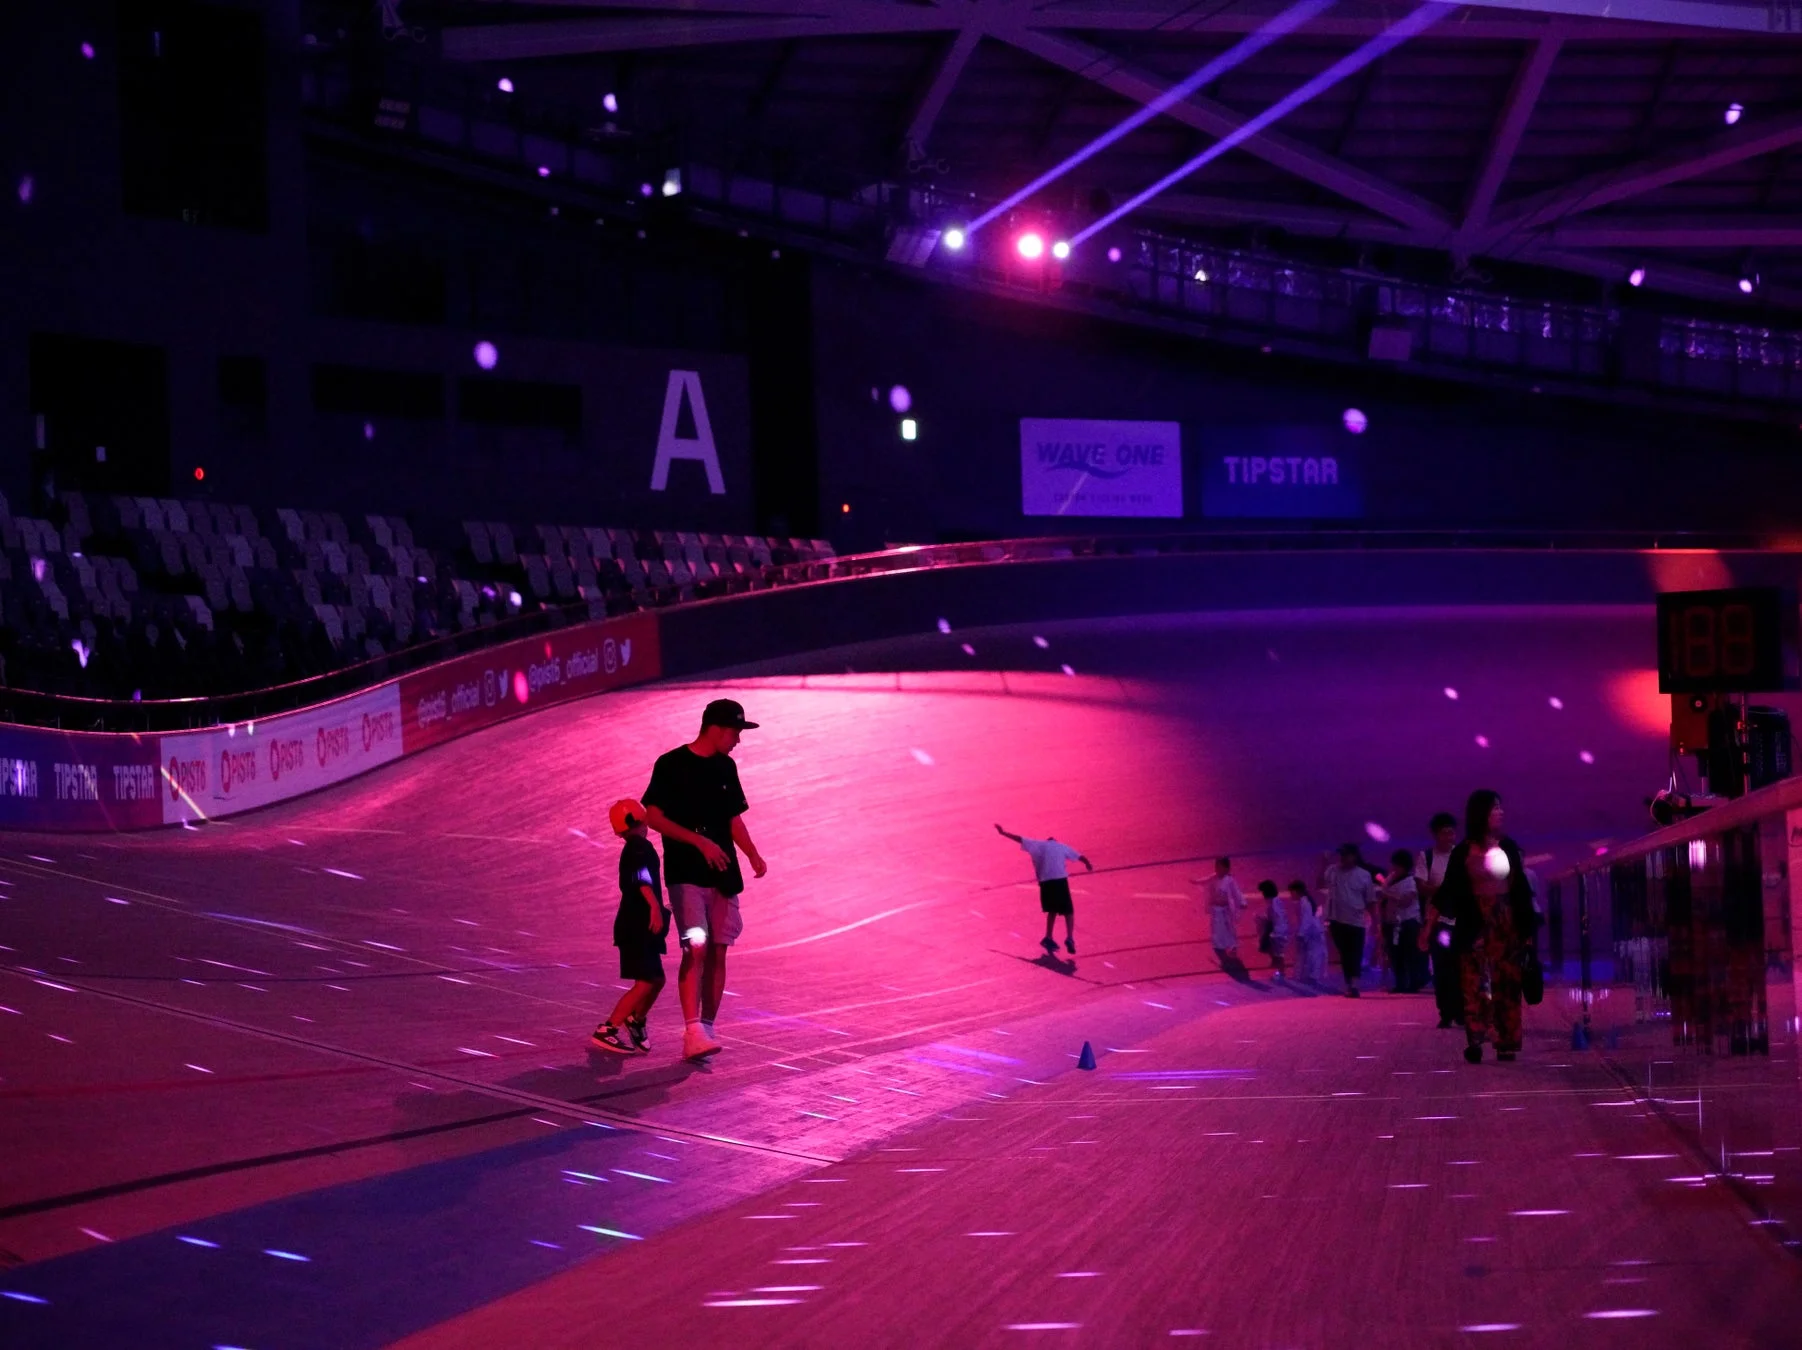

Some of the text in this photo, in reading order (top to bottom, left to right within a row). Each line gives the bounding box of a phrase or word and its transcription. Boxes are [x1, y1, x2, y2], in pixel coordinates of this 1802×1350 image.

[650, 369, 726, 495] A
[1036, 441, 1165, 466] WAVE ONE
[1223, 456, 1340, 485] TIPSTAR
[54, 763, 99, 801] TIPSTAR
[113, 765, 155, 800] TIPSTAR
